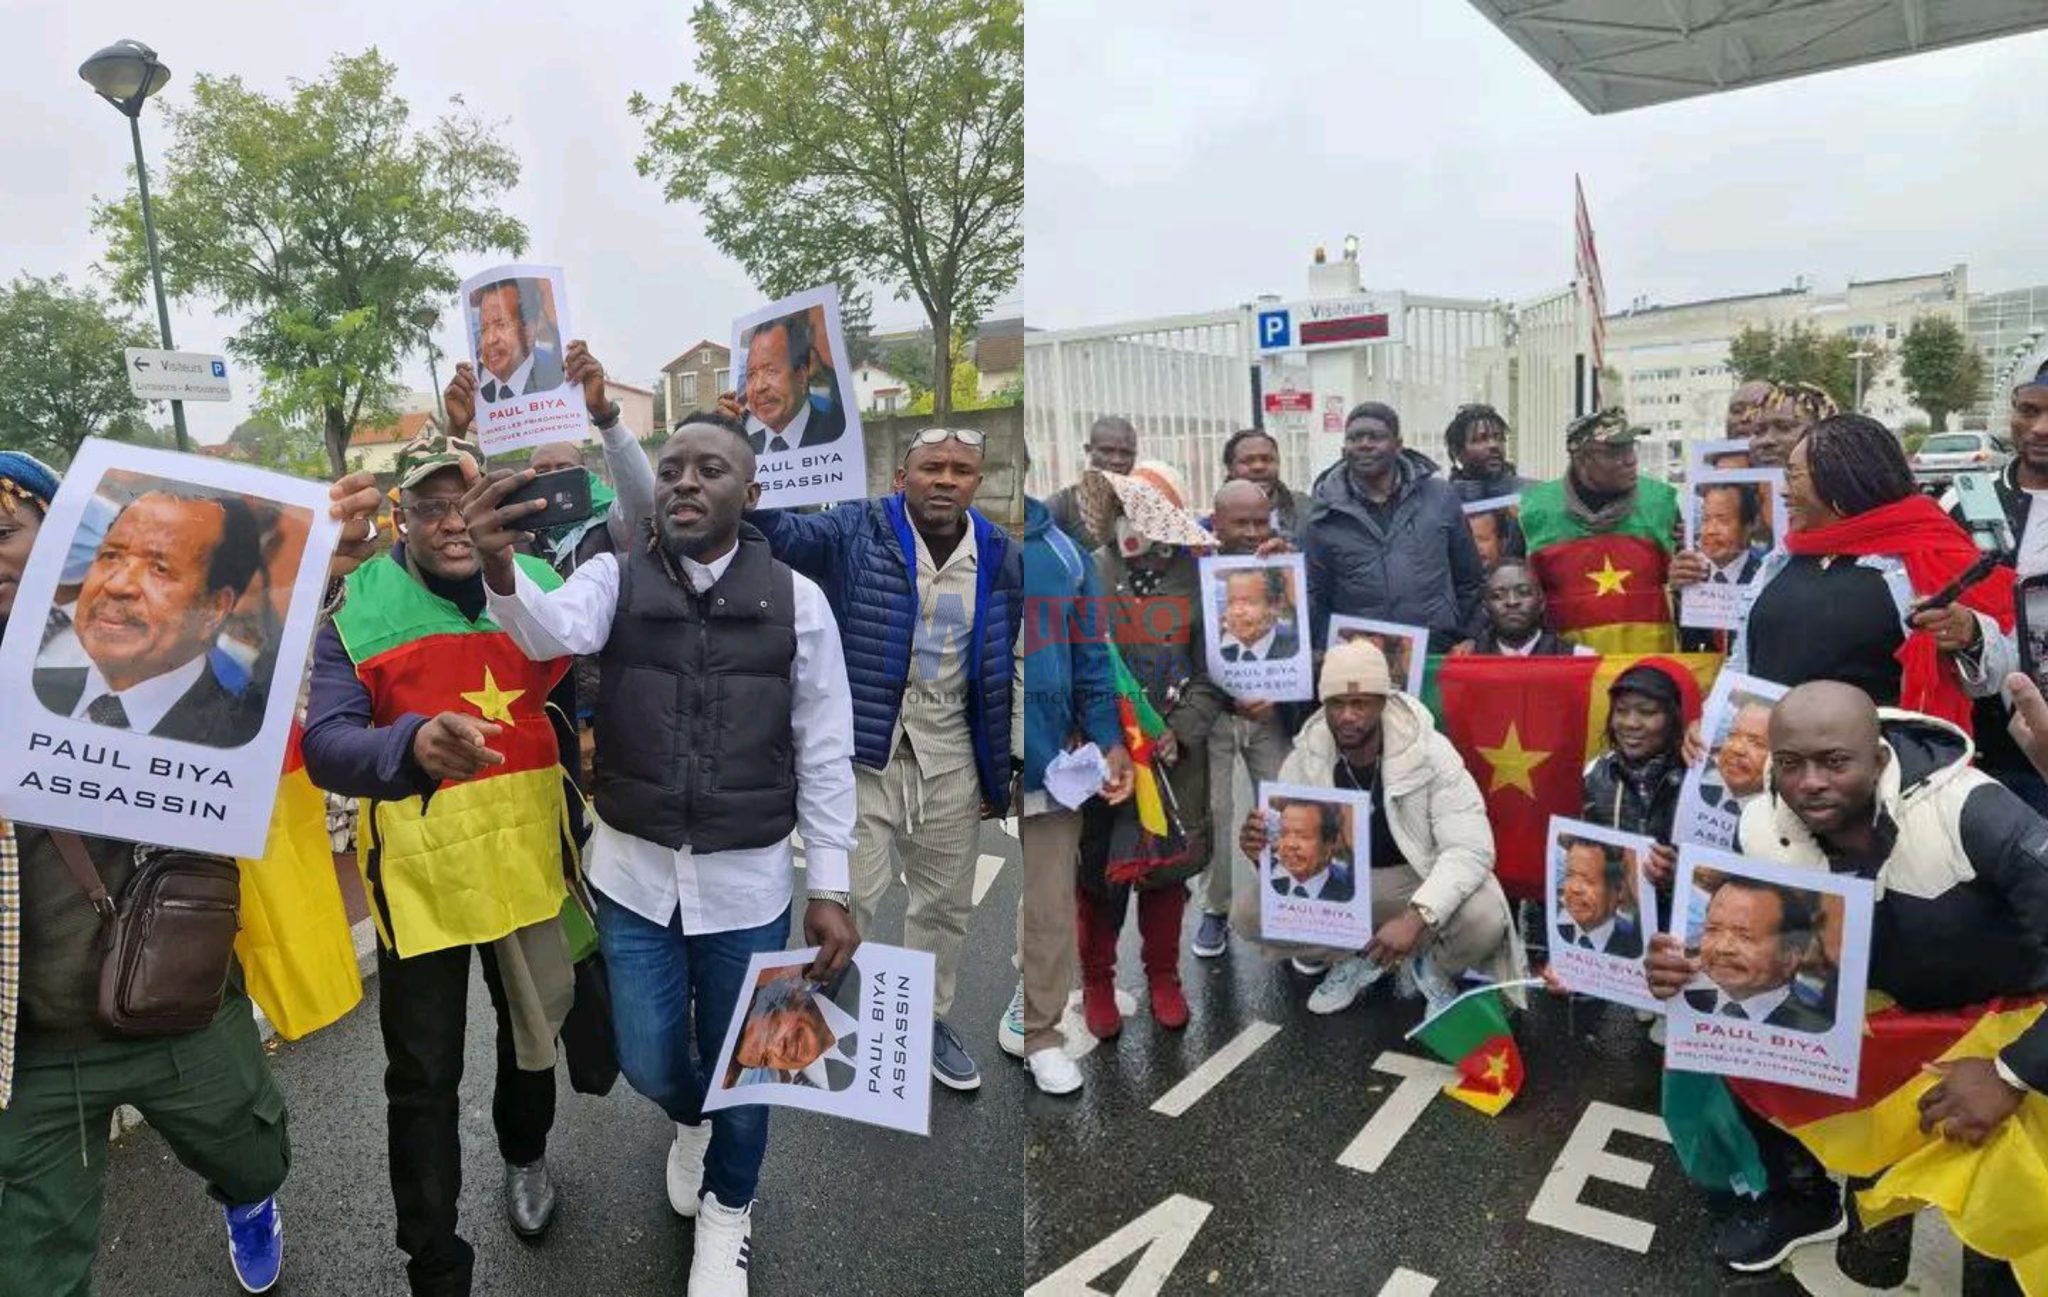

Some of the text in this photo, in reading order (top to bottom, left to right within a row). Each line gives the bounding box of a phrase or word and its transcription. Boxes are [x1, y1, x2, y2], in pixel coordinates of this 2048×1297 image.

[1311, 302, 1375, 319] Visiteurs
[161, 361, 203, 374] Visiteurs
[489, 399, 566, 421] PAUL BIYA
[758, 452, 843, 474] AUL BIYA
[759, 471, 843, 491] SSASSIN
[29, 732, 233, 788] PAUL BIYA
[19, 771, 227, 821] ASSASSIN
[1697, 812, 1733, 832] PAU
[868, 971, 887, 1093] PAUL BIYA
[893, 976, 910, 1100] ASSASSIN
[1695, 1023, 1829, 1056] PAUL BIYA
